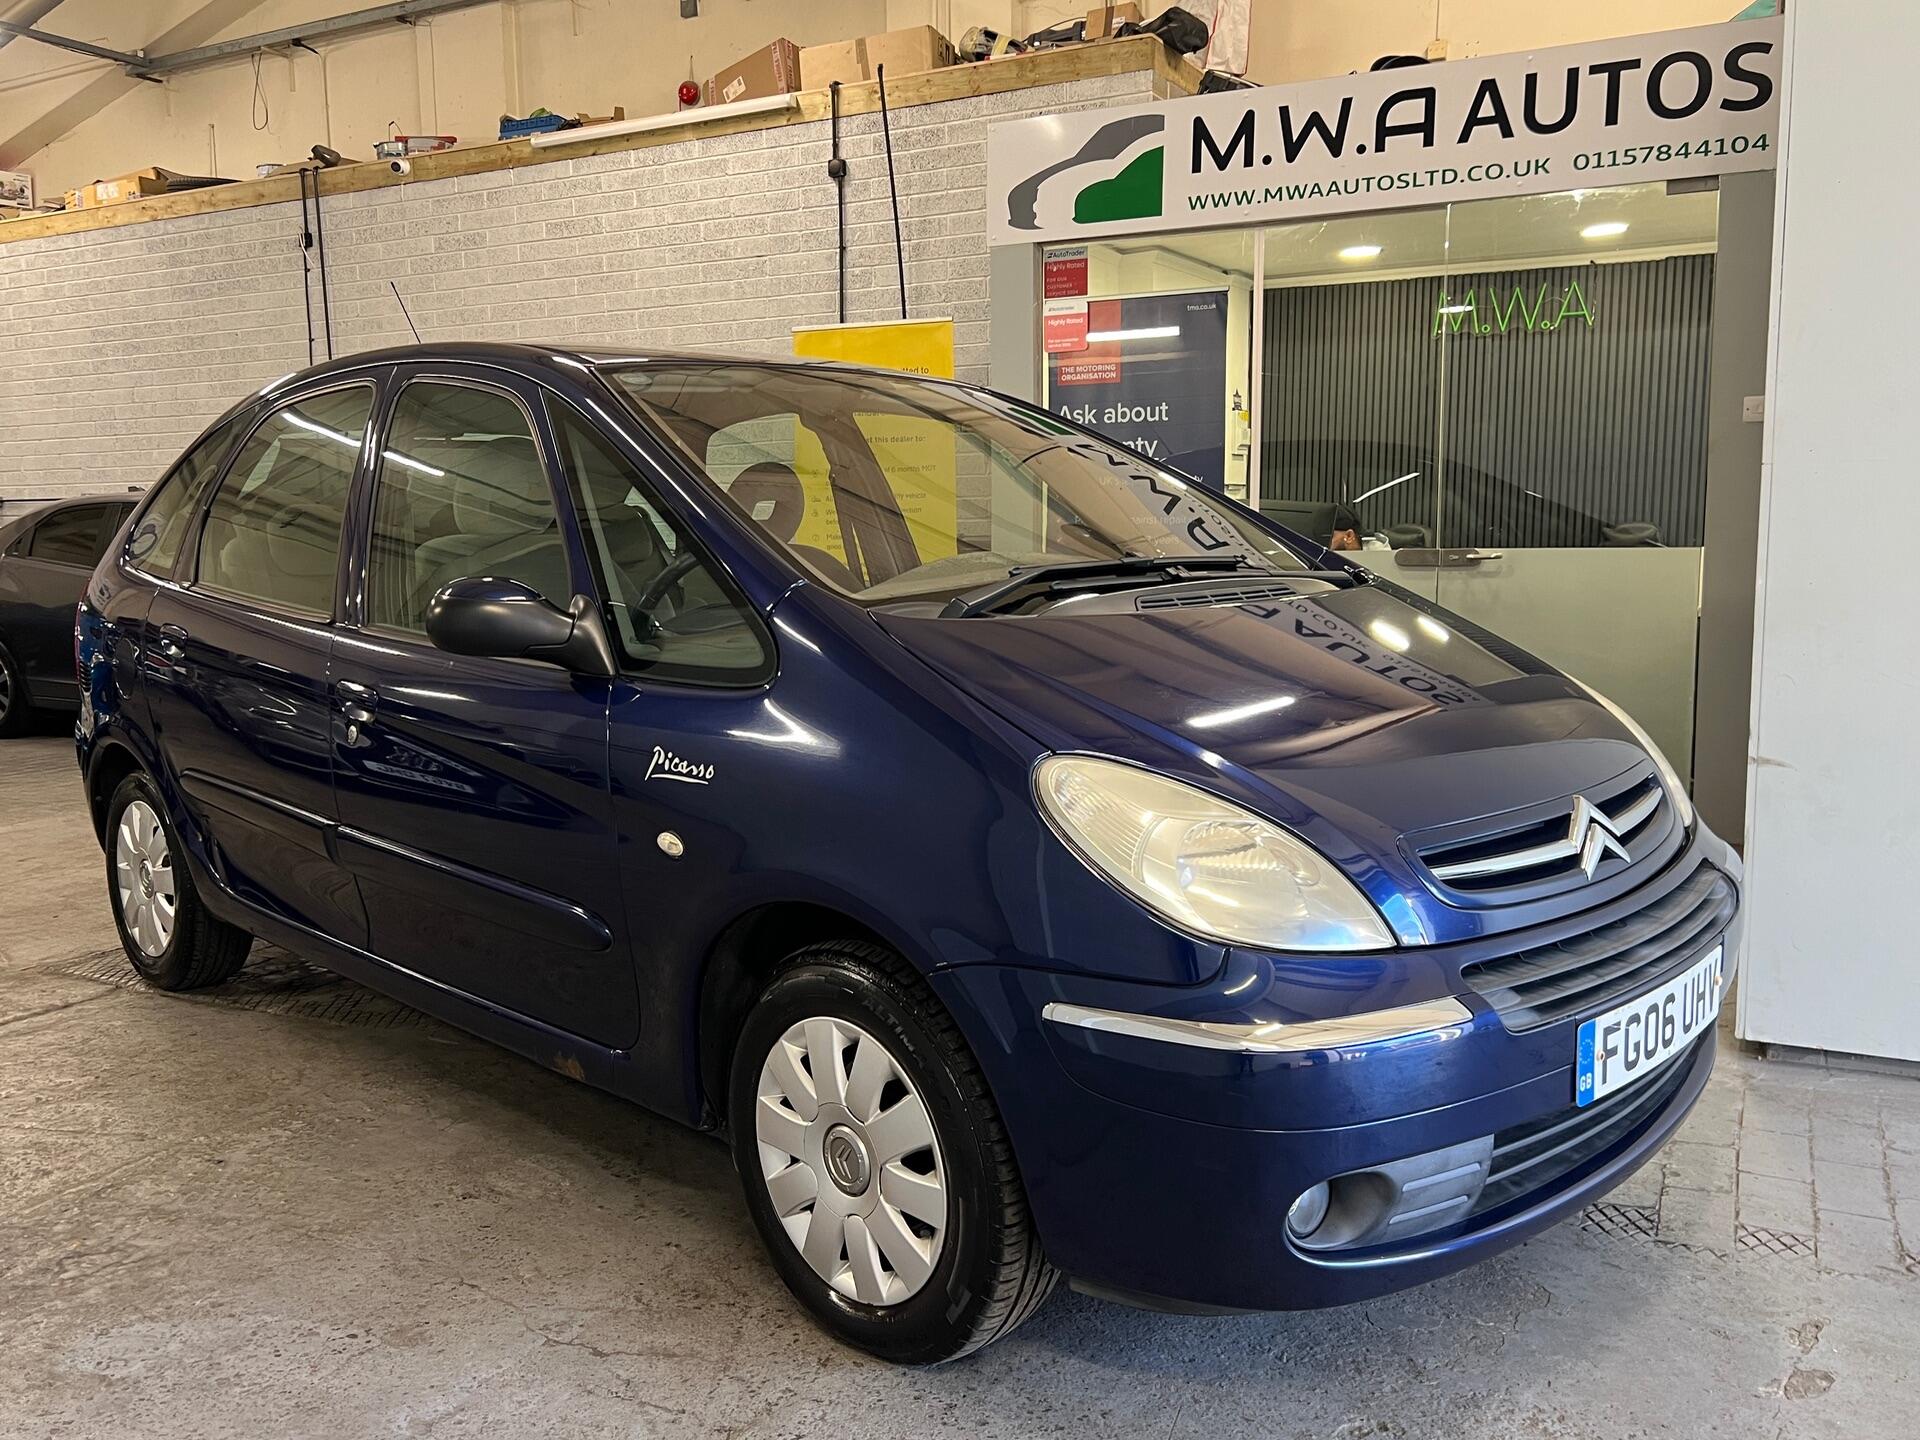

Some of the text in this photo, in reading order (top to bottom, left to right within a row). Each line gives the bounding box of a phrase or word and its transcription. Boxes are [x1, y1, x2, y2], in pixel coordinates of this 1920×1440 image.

[1191, 41, 1774, 174] M.W.A AUTOS
[1188, 133, 1770, 211] WWW.MWAAUTOSLTD.CO.UK 01157844104
[1061, 364, 1117, 374] THE MOTORING
[1061, 372, 1117, 382] ORGANISATION
[1060, 402, 1169, 425] Ask about
[890, 434, 914, 443] dealer
[644, 745, 715, 784] Picasso
[1601, 957, 1719, 1086] FG06 UHV
[1579, 1072, 1593, 1092] GB
